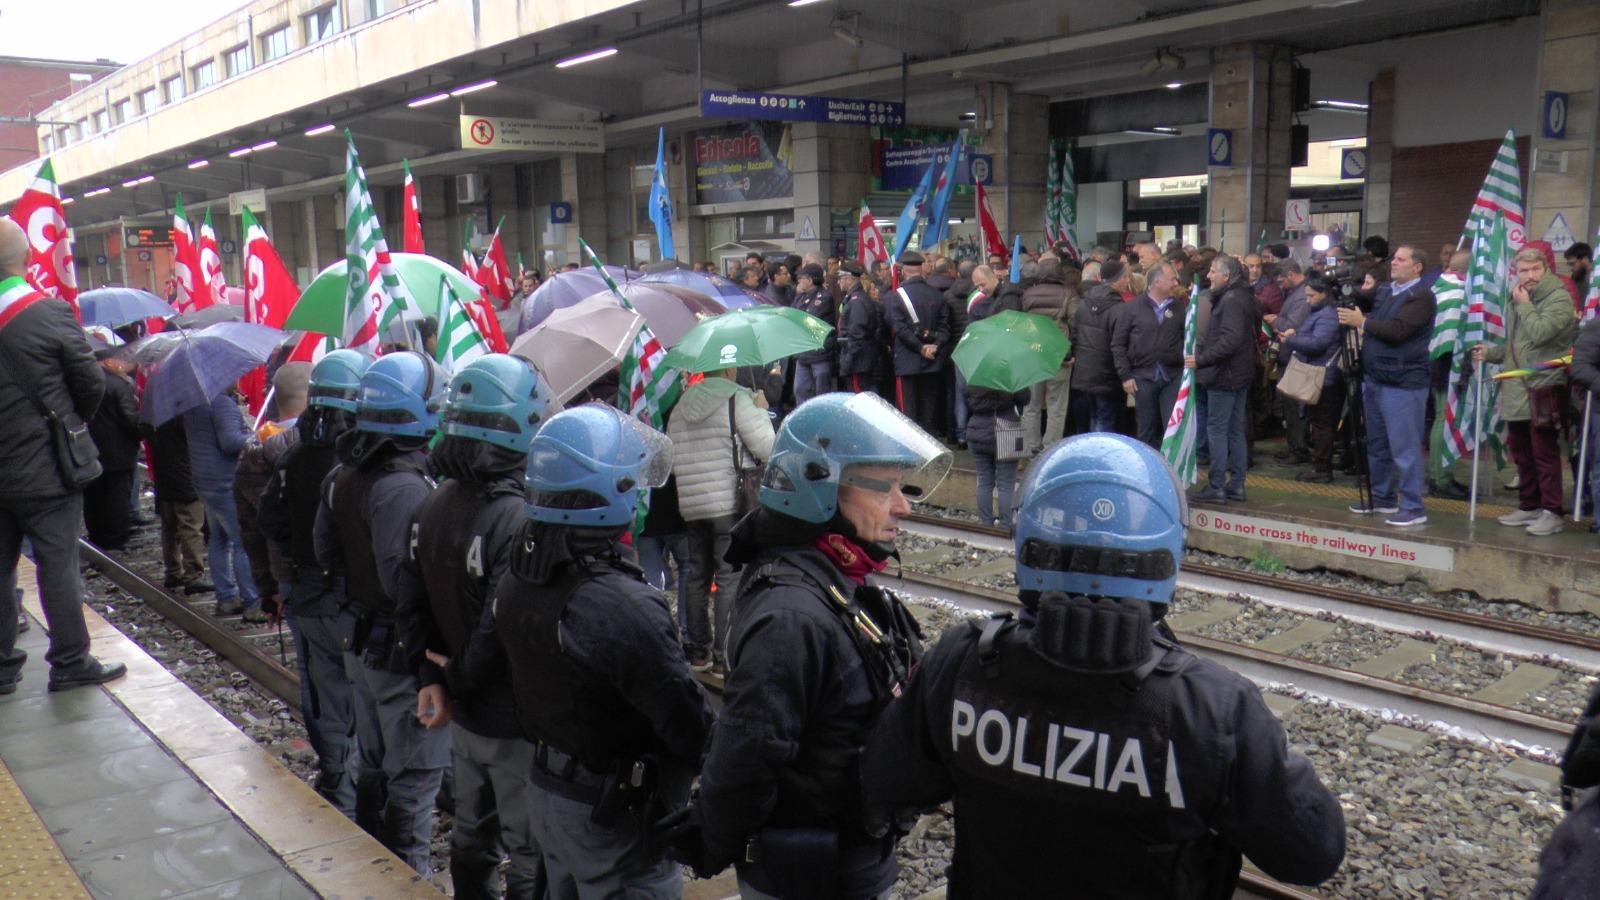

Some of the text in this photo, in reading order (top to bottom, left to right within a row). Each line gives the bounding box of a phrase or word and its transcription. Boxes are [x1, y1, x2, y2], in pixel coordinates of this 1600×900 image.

[709, 93, 756, 105] Accoglienza
[828, 101, 866, 111] Uscita/Exit
[828, 111, 867, 122] Biglietteria
[696, 130, 761, 164] Edicola
[1214, 517, 1417, 561] Do not cross the railway lines
[951, 698, 1152, 797] POLIZIA
